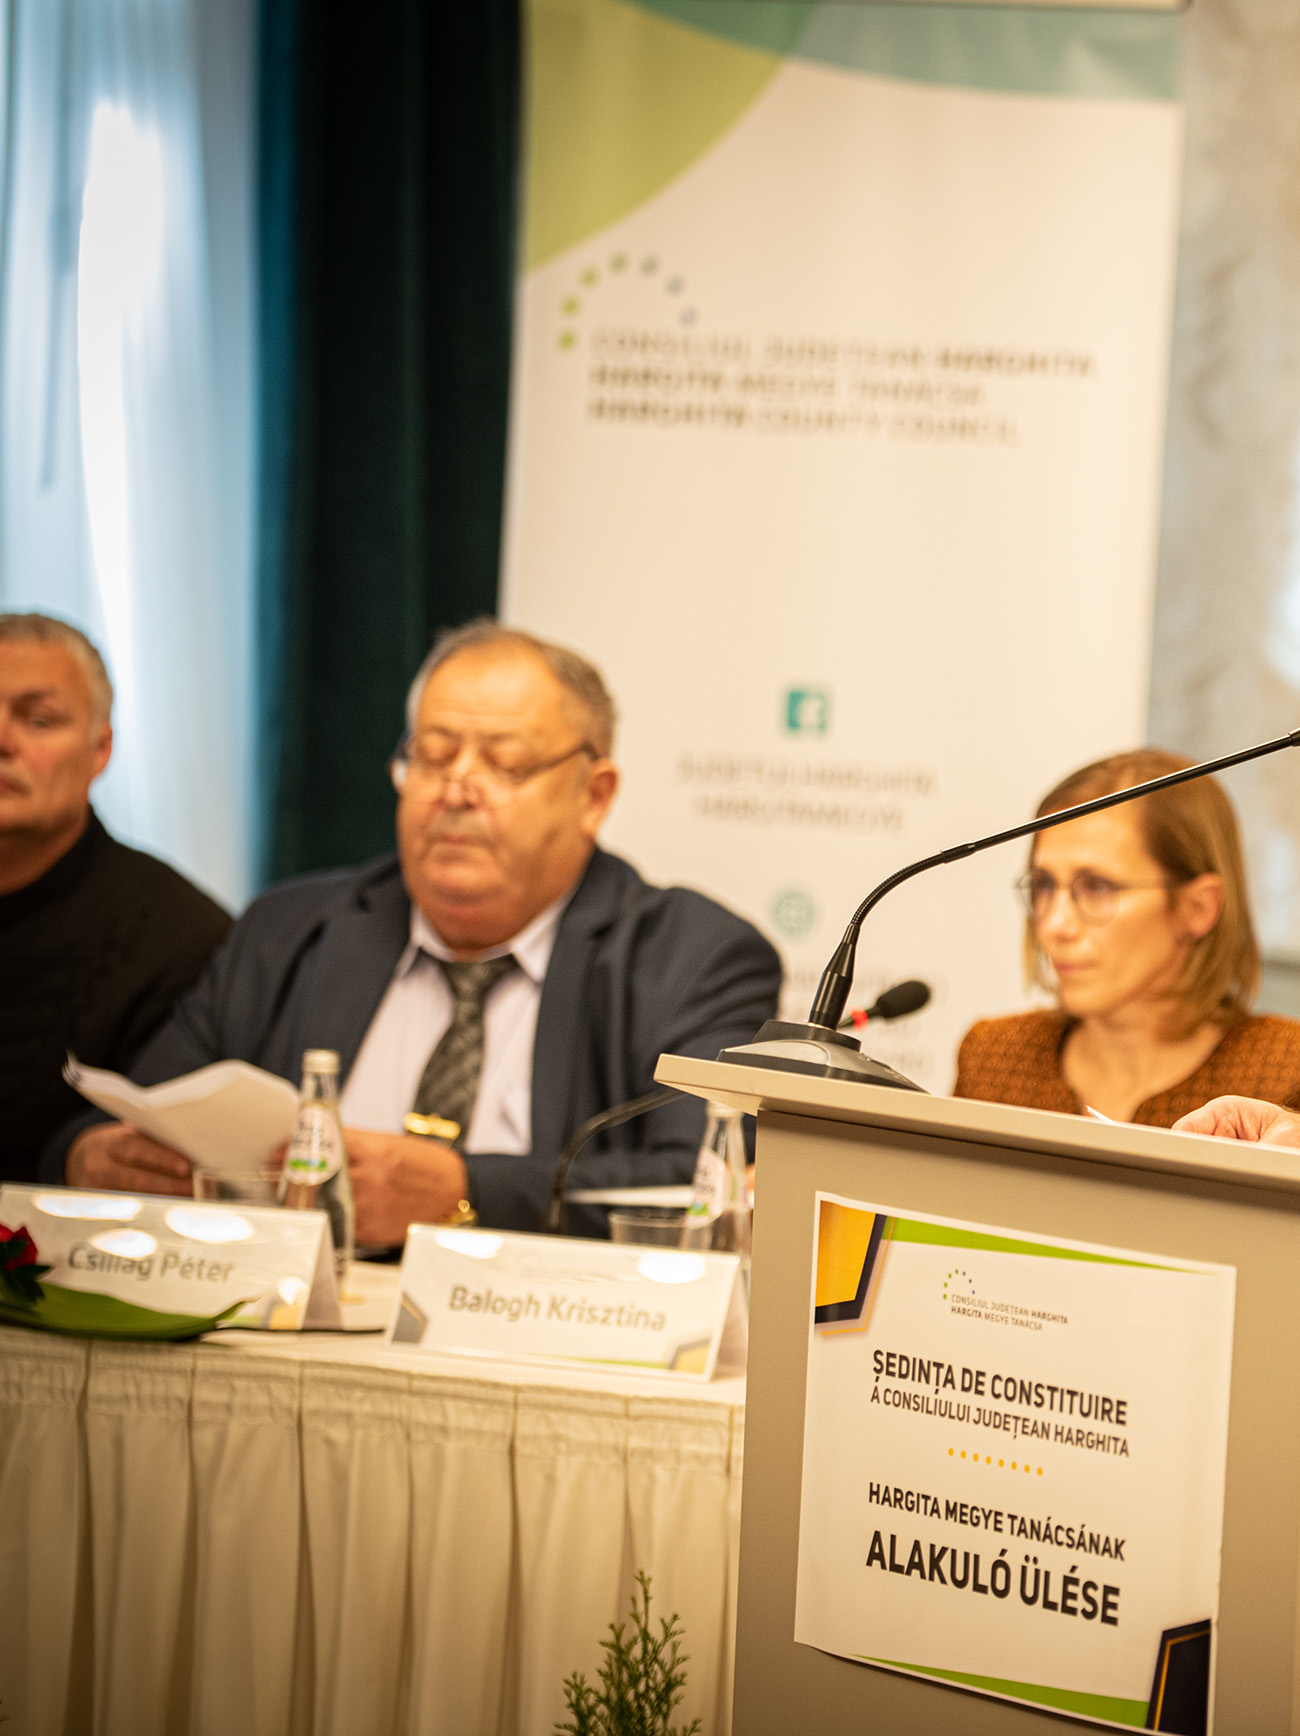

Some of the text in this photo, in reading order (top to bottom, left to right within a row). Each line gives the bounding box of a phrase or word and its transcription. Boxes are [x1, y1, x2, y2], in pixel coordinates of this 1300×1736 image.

[159, 1250, 234, 1283] Péter
[448, 1283, 668, 1332] Balogh Krisztina
[984, 1312, 1010, 1326] MEGYE
[961, 1367, 987, 1396] DE
[991, 1373, 1128, 1427] CONSTITUIRE
[1054, 1424, 1130, 1459] HARGHITA
[868, 1481, 1127, 1563] HARGITA MEGYE TANÁCSÁNAK
[865, 1529, 1121, 1628] ALAKULÓ ÜLÉSE
